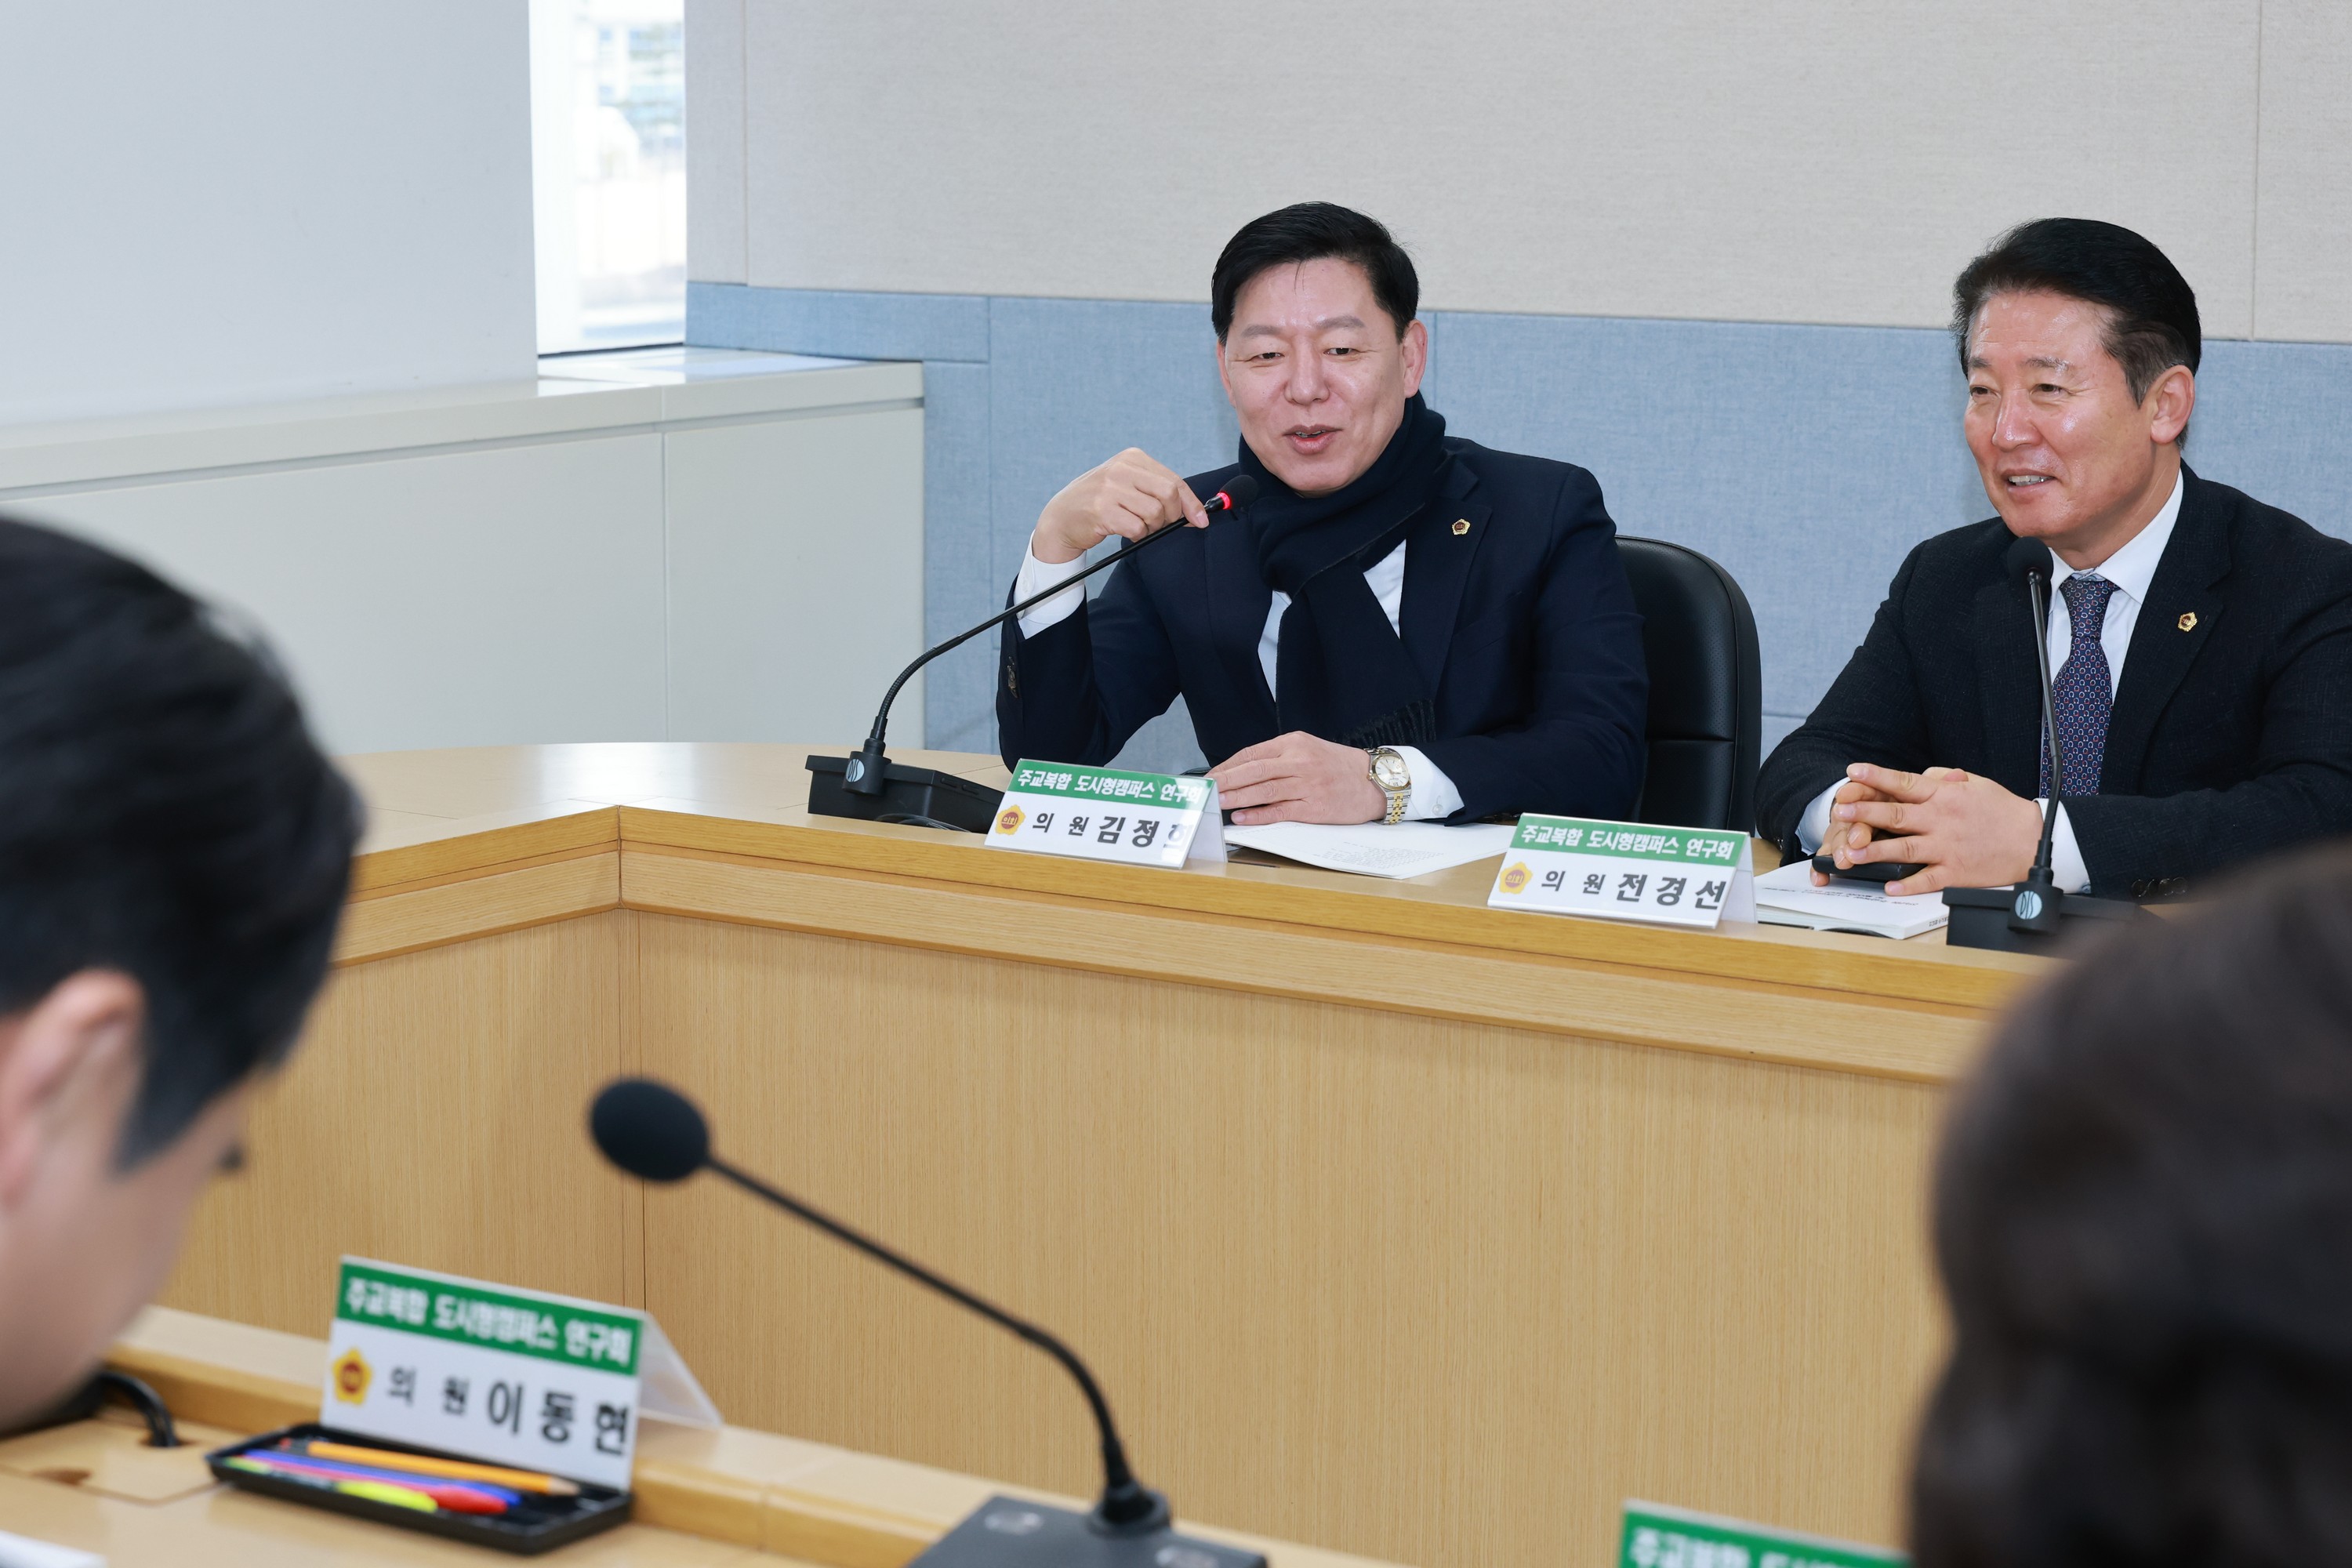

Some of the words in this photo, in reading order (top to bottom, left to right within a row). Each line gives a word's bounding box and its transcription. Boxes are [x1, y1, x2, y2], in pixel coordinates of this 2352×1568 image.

[1018, 769, 1072, 791] 주교복합
[1074, 775, 1156, 798] 도시형캠퍼스
[1160, 783, 1203, 804] 연구회
[1521, 825, 1583, 847] 주교복합
[1586, 831, 1679, 855] 도시형캠퍼스
[1685, 838, 1735, 860] 연구회
[1616, 873, 1726, 910] 전경선
[488, 1379, 626, 1456] 이동현
